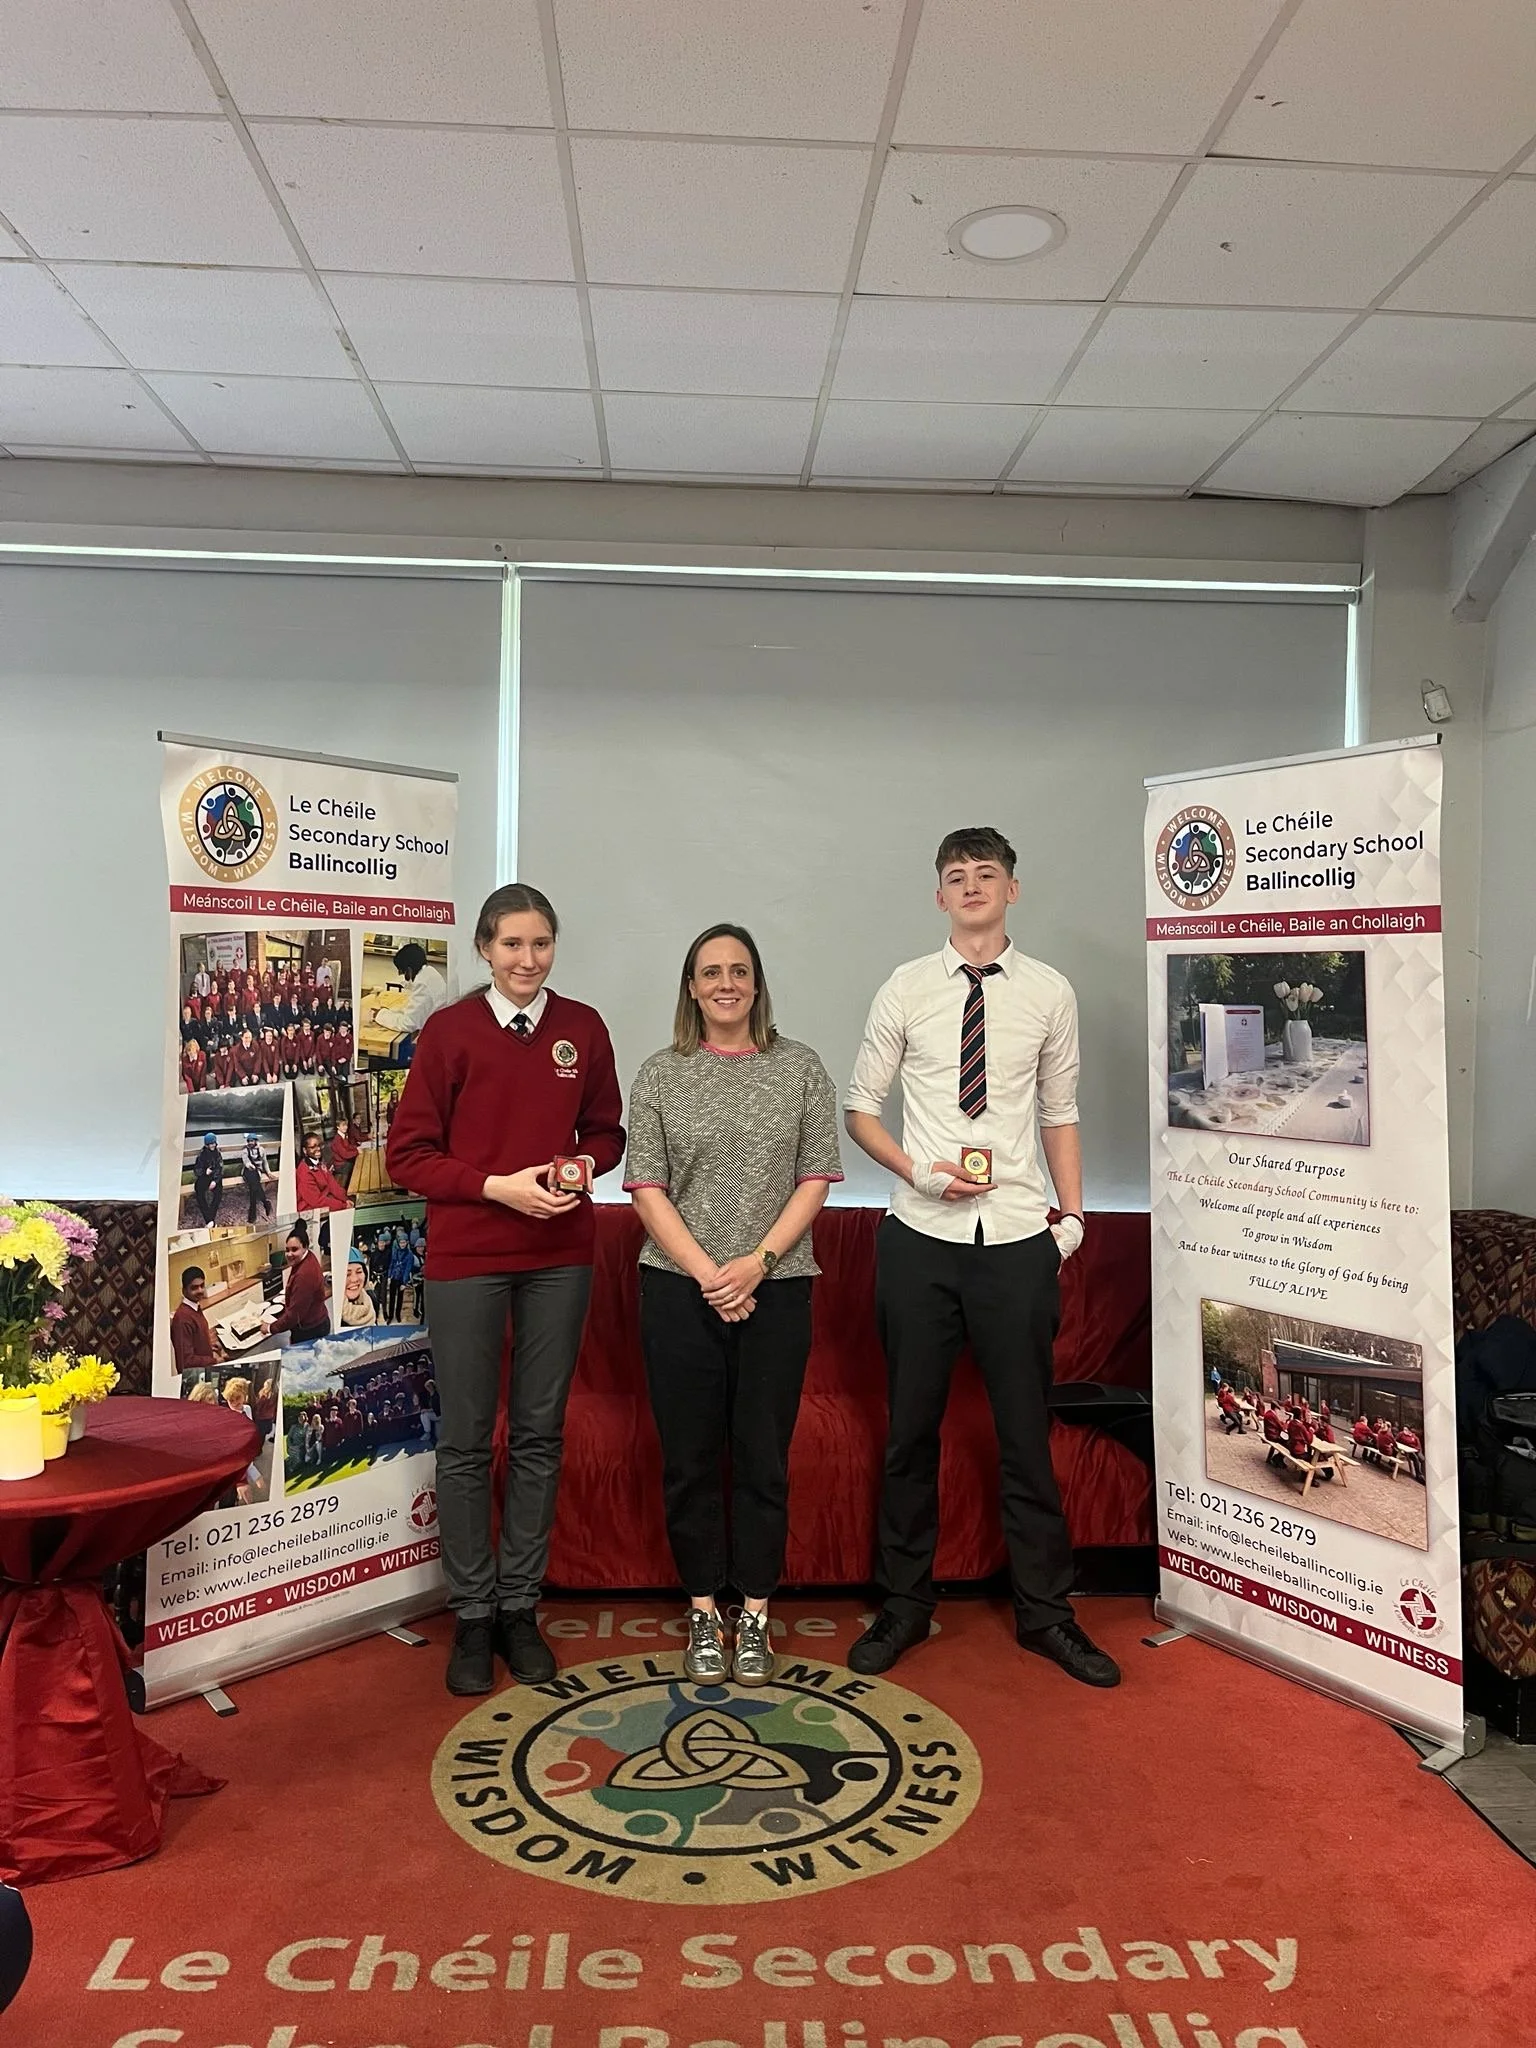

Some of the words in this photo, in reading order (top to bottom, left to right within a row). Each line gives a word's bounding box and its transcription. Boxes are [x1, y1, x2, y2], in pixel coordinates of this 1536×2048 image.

[194, 768, 263, 799] WELCOME
[289, 795, 312, 813] Le
[317, 796, 376, 821] Chéile
[1168, 808, 1224, 834] WELCOME
[1246, 819, 1267, 835] Le
[1272, 811, 1333, 832] Chéile
[181, 811, 218, 877] WISDOM
[234, 821, 276, 880] WITNESS
[289, 824, 390, 852] Secondary
[395, 834, 449, 855] School
[1246, 840, 1347, 863] Secondary
[1353, 831, 1424, 855] School
[289, 852, 398, 880] Ballincollig
[1157, 854, 1187, 907] WISDOM
[1200, 849, 1234, 907] WITNESS
[1246, 867, 1355, 891] Ballincollig
[183, 892, 253, 910] Meánscoil
[257, 897, 277, 911] Le
[280, 898, 329, 916] Chéile,
[333, 901, 366, 916] Baile
[370, 906, 388, 916] an
[392, 905, 451, 922] Chollaigh
[1156, 922, 1217, 936] Meánscoil
[1220, 922, 1236, 934] Le
[1239, 918, 1286, 934] Chéile,
[1289, 917, 1325, 932] Baile
[1330, 920, 1348, 930] an
[1352, 914, 1425, 932] Chollaigh
[1228, 1152, 1251, 1167] Our
[1252, 1155, 1292, 1172] Shared
[1295, 1162, 1346, 1180] Purpose
[1167, 1171, 1182, 1182] The
[1184, 1174, 1196, 1184] Le
[1197, 1174, 1225, 1188] Chéile
[1226, 1179, 1274, 1197] Secondary
[1274, 1186, 1306, 1200] School
[1308, 1190, 1368, 1210] Community
[1369, 1198, 1378, 1208] is
[1380, 1198, 1401, 1212] here
[1404, 1202, 1420, 1215] to:
[1200, 1198, 1240, 1213] Welcome
[1242, 1204, 1254, 1215] all
[1256, 1206, 1284, 1222] people
[1286, 1211, 1304, 1223] and
[1306, 1213, 1321, 1226] all
[1323, 1218, 1382, 1234] experiences
[1242, 1227, 1254, 1238] To
[1254, 1232, 1278, 1244] grow
[1280, 1234, 1290, 1245] in
[1292, 1236, 1333, 1252] Wisdom
[1178, 1240, 1197, 1252] And
[1200, 1244, 1210, 1254] to
[1211, 1244, 1231, 1258] bear
[1233, 1250, 1266, 1264] witness
[1269, 1256, 1279, 1266] to
[1281, 1256, 1296, 1270] the
[1298, 1261, 1326, 1278] Glory
[1328, 1266, 1342, 1281] of
[1342, 1268, 1364, 1283] God
[1366, 1273, 1379, 1288] by
[1382, 1274, 1410, 1293] being
[1248, 1275, 1290, 1292] FULLY
[1288, 1283, 1328, 1300] ALIVE
[161, 1535, 199, 1559] Tel:
[206, 1522, 242, 1547] 021
[248, 1511, 284, 1536] 236
[290, 1496, 339, 1524] 2879
[1165, 1480, 1196, 1504] Tel:
[1200, 1492, 1228, 1515] 021
[1232, 1504, 1264, 1528] 236
[1270, 1516, 1316, 1546] 2879
[160, 1561, 209, 1586] Email:
[213, 1507, 398, 1570] info@lecheileballincollig.ie
[160, 1588, 200, 1608] Web:
[204, 1531, 390, 1597] www.lecheileballincollig.ie
[1167, 1508, 1204, 1530] Email:
[1206, 1520, 1384, 1596] info@lecheileballincollig.ie
[158, 1598, 257, 1642] WELCOME
[284, 1567, 356, 1603] WISDOM
[380, 1541, 440, 1572] WITNES
[1167, 1528, 1198, 1548] Web:
[1200, 1541, 1374, 1615] www.lecheileballincollig.ie
[1168, 1552, 1244, 1595] WELCOME
[1267, 1590, 1338, 1632] WISDOM
[1364, 1628, 1450, 1676] WITNESS
[531, 1658, 877, 1702] WELME
[450, 1737, 637, 1885] WISDOM
[750, 1738, 963, 1886] WITNESS
[84, 1937, 231, 1992] Le
[264, 1932, 645, 1993] Chéile
[679, 1926, 1299, 1993] Secondary
